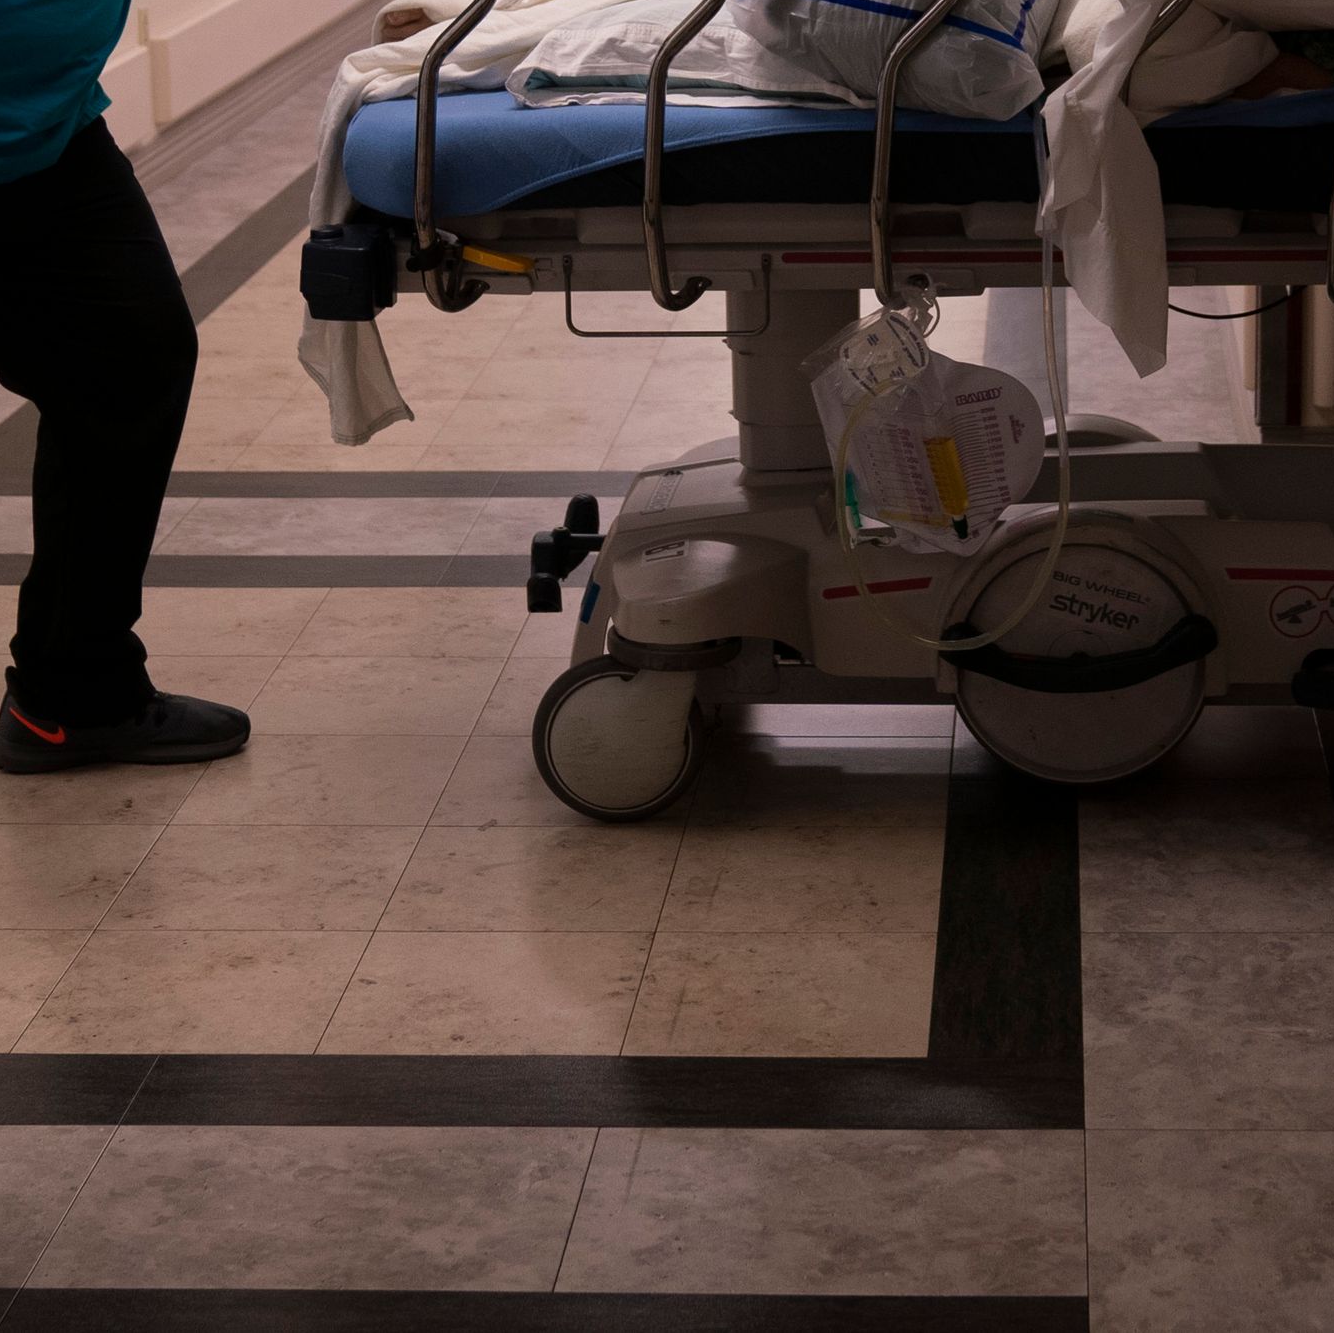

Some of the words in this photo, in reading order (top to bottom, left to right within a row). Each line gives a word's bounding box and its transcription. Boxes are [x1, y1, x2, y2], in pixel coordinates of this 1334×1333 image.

[955, 387, 1002, 406] BARD
[1052, 571, 1082, 586] BIG
[1085, 580, 1147, 605] WHEEL
[1048, 593, 1140, 630] stryker
